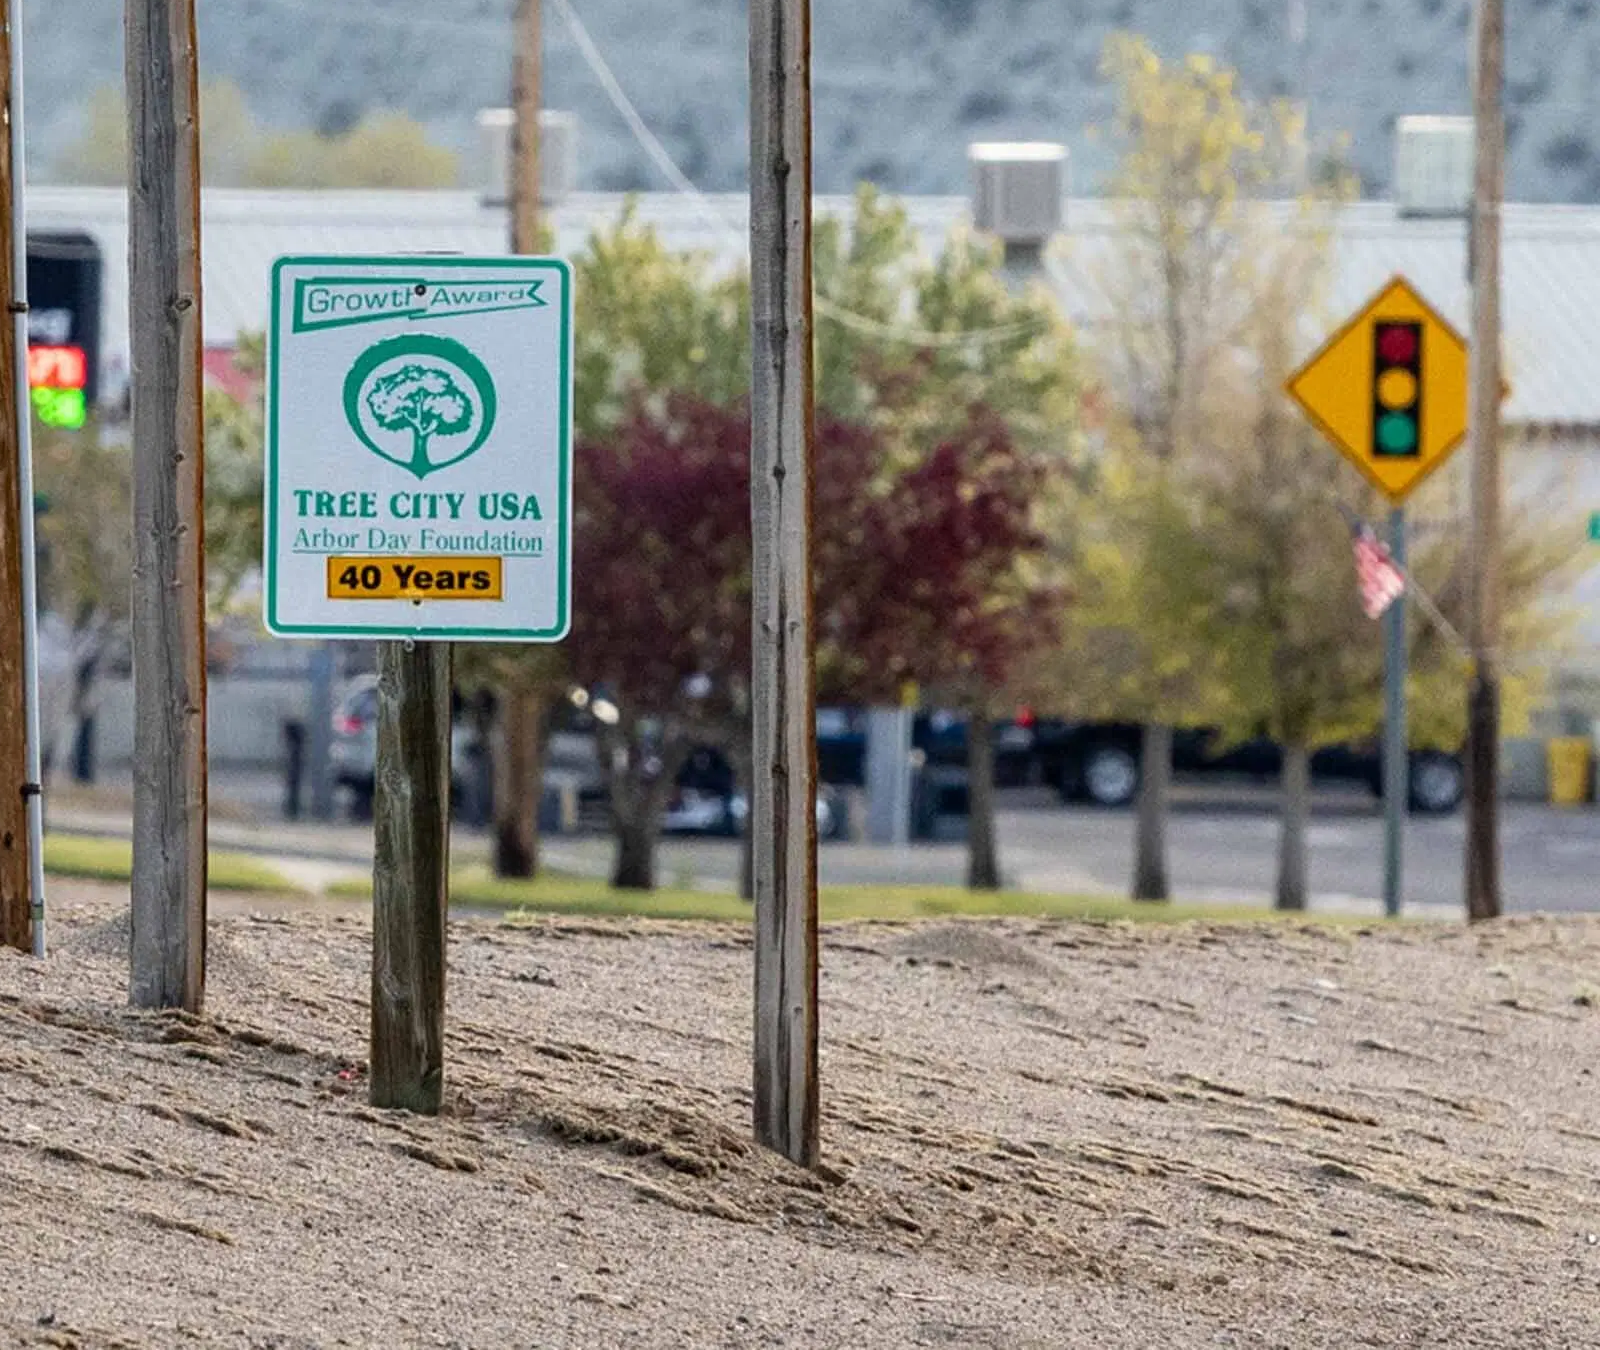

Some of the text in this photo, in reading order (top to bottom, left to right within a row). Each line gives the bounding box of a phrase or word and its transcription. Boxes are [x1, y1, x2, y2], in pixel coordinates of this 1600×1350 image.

[430, 287, 525, 307] Award
[293, 489, 543, 521] TREE CITY USA
[292, 527, 544, 553] Arbor Day Foundation
[339, 564, 491, 591] 40 Years
